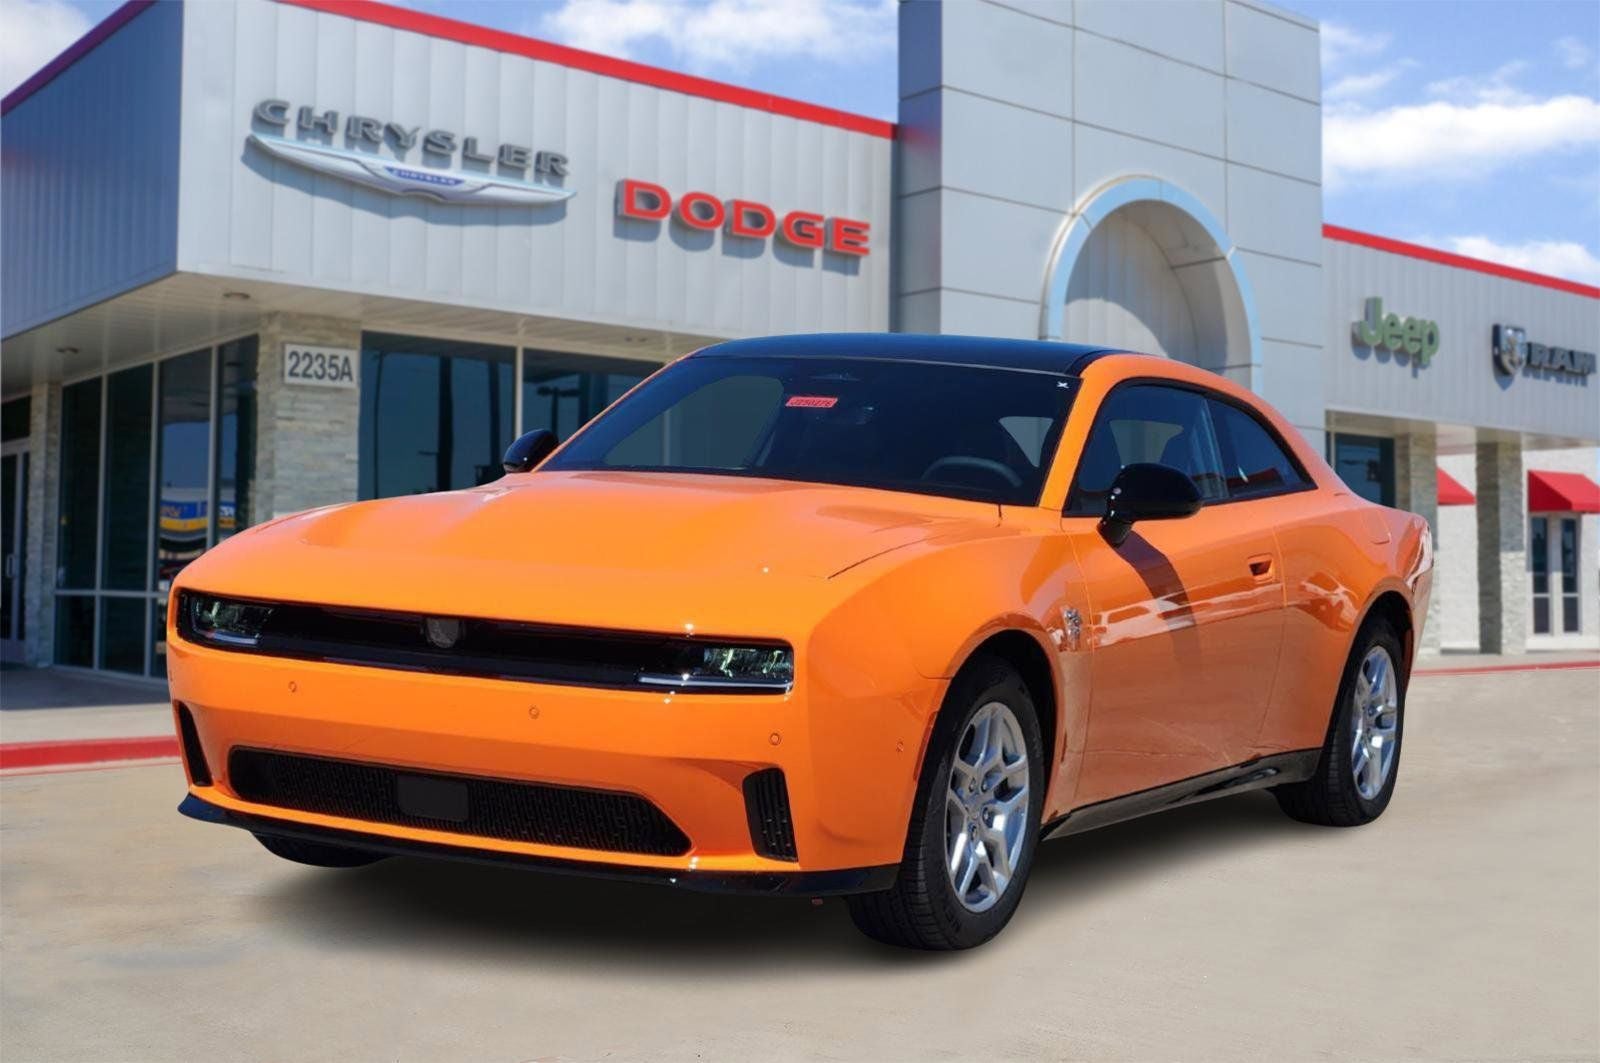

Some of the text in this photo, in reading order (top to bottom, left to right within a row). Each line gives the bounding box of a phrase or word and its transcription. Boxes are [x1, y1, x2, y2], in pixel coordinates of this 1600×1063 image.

[252, 99, 568, 176] CHRYSLER
[615, 178, 870, 256] DODGE
[288, 350, 353, 382] 2235A
[1353, 297, 1440, 366] Jeep
[1526, 342, 1596, 375] RAM
